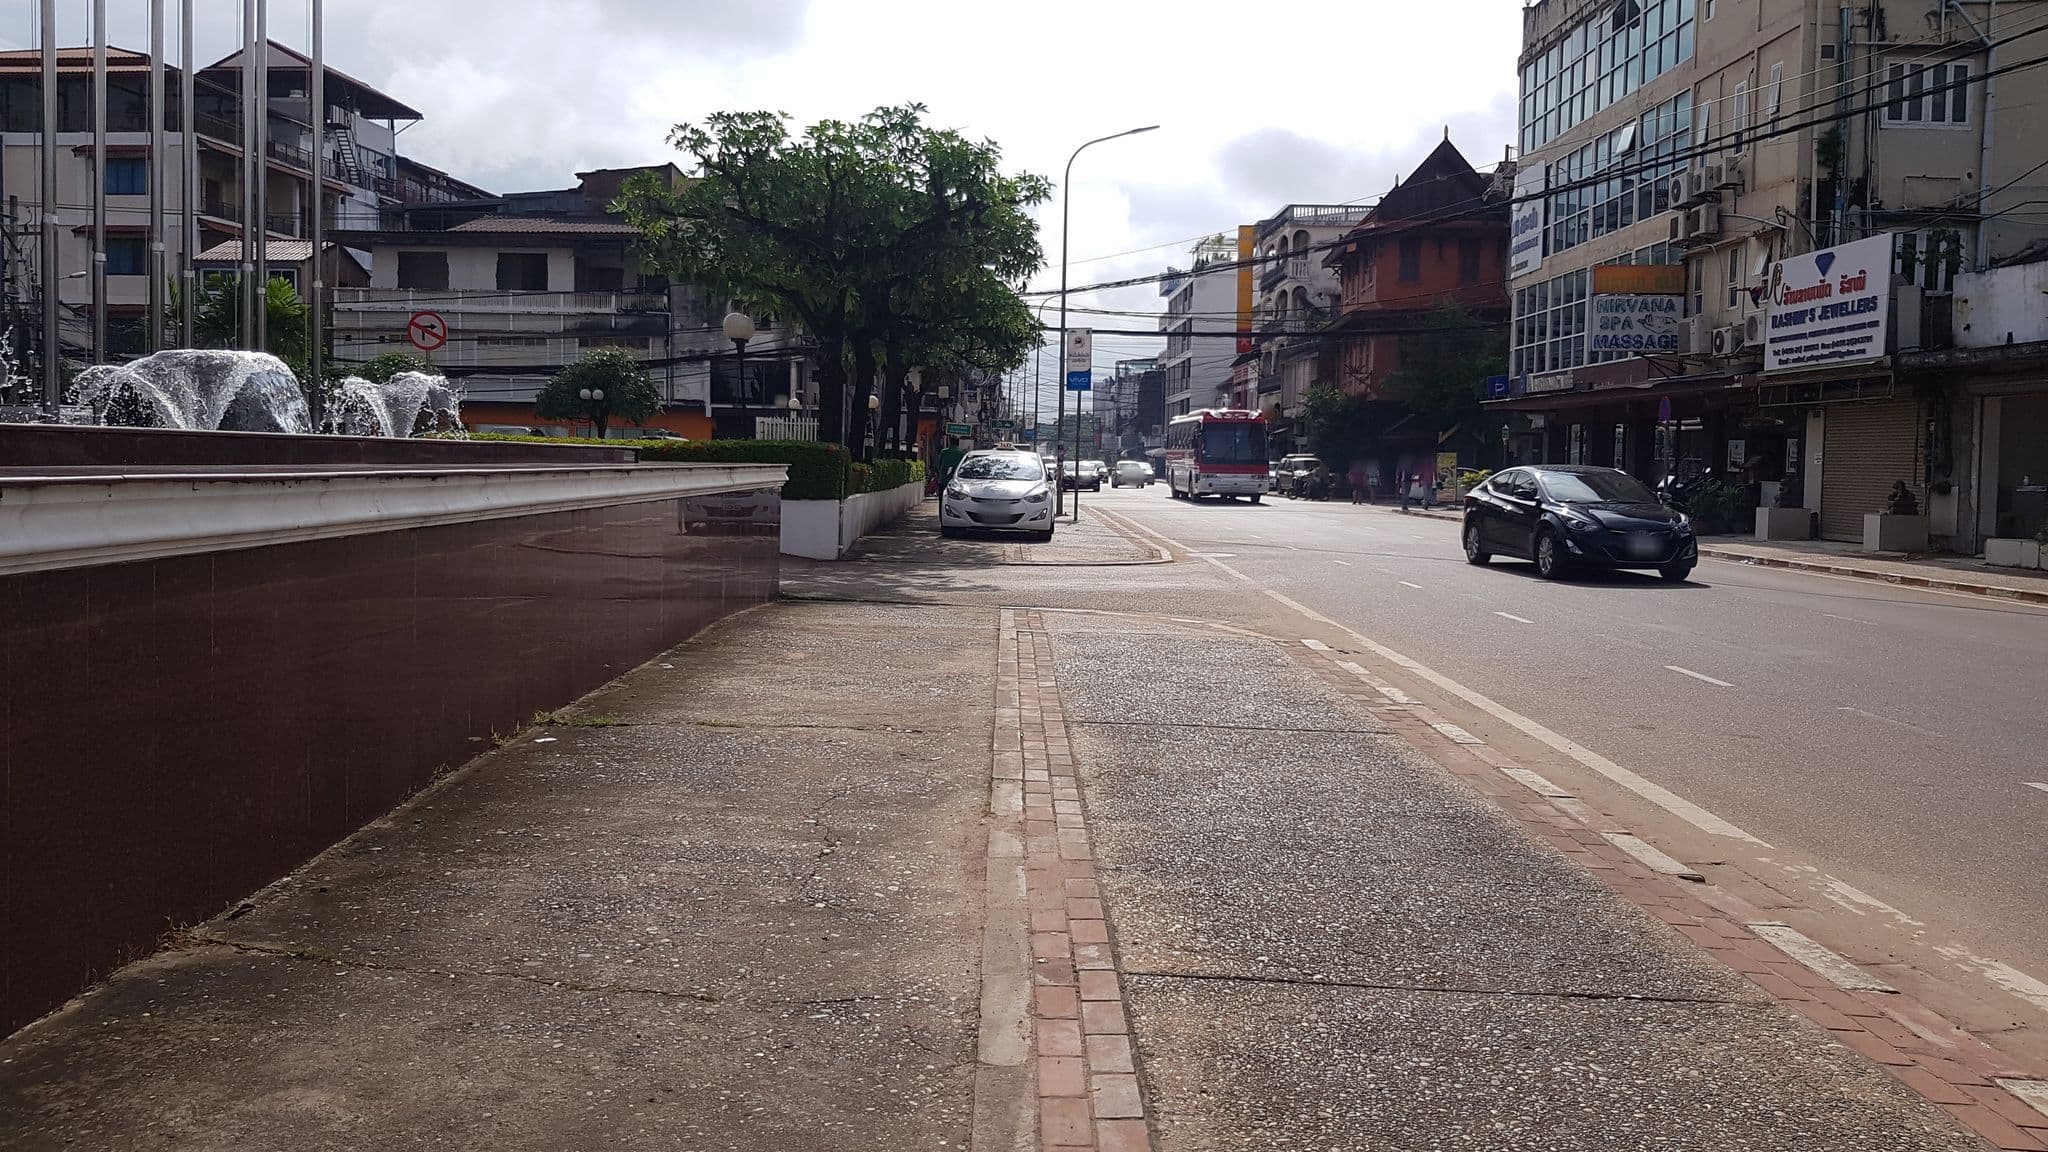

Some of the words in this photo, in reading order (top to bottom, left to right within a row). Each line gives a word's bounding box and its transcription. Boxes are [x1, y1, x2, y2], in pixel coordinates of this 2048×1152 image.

[1596, 298, 1676, 313] NIRVANA
[1818, 296, 1879, 321] JEWELLERS
[1600, 316, 1633, 330] SPA
[1593, 334, 1678, 350] MASSAGE
